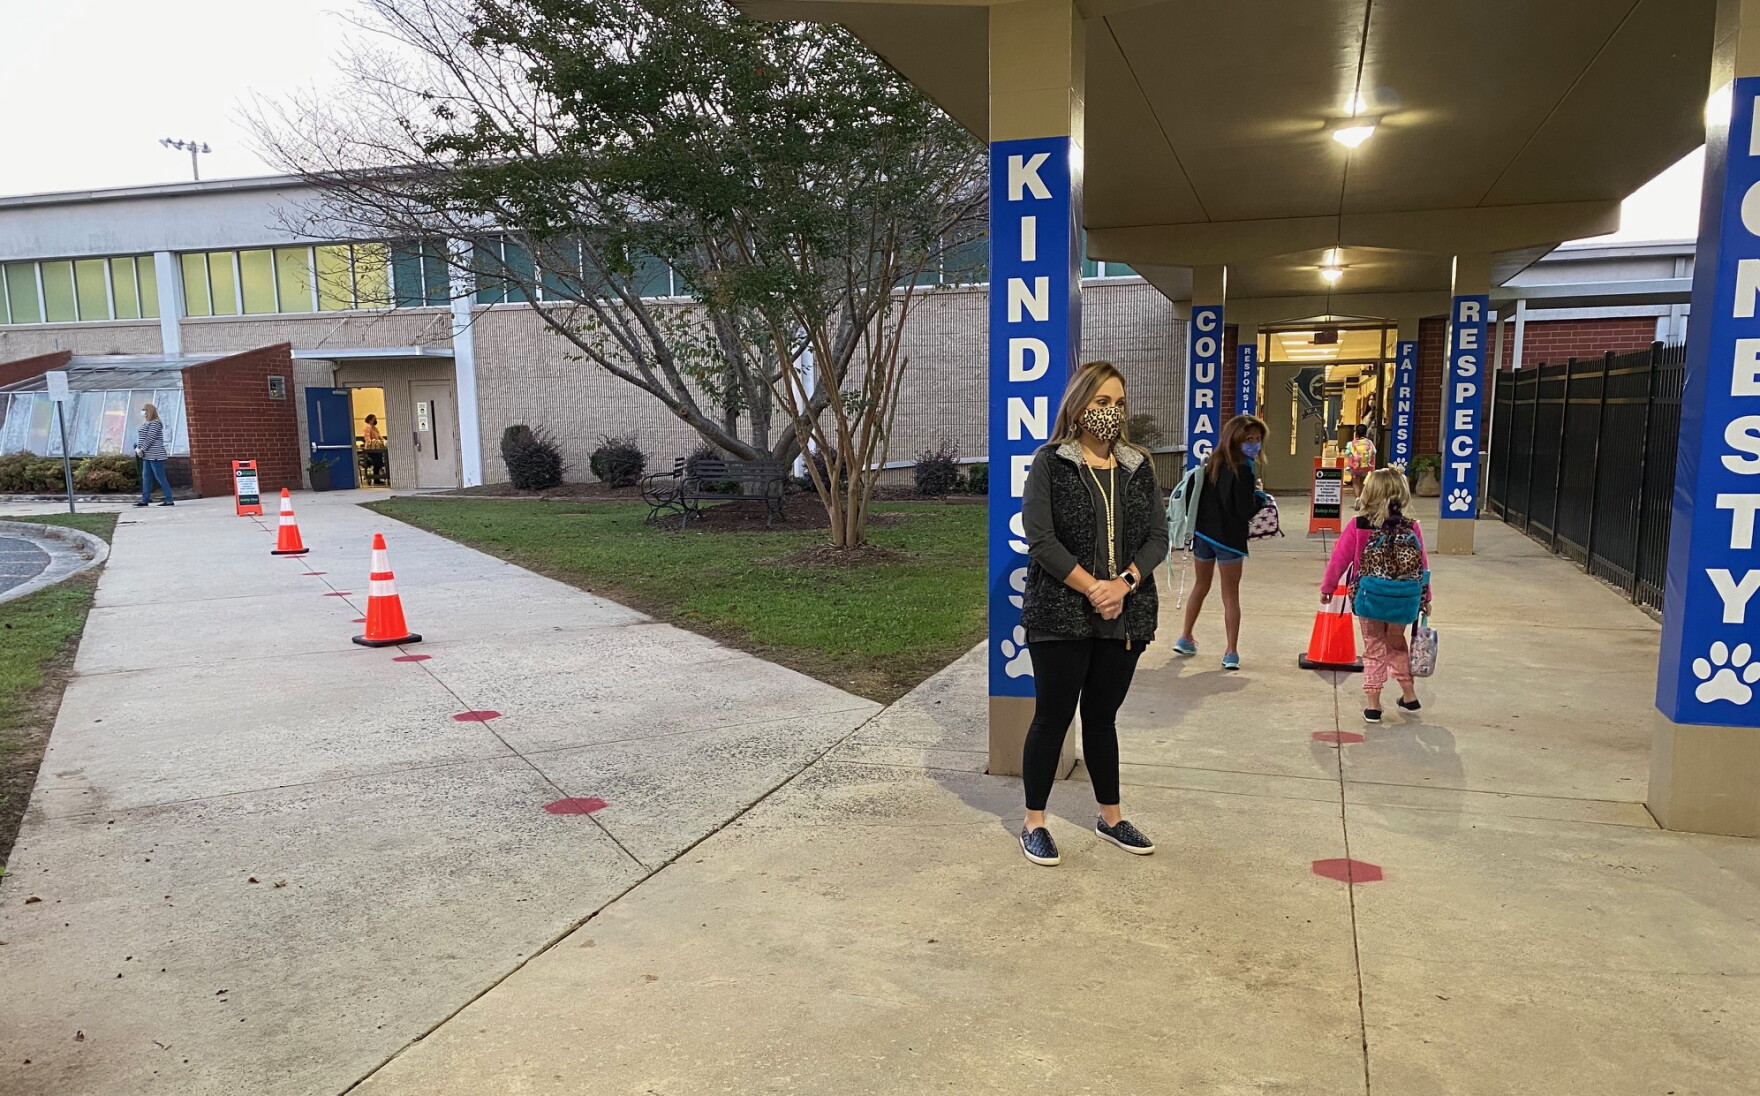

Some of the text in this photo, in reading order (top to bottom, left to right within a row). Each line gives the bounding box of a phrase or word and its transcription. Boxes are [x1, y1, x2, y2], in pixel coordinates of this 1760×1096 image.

[1192, 310, 1217, 468] COURAG
[1396, 344, 1413, 454] FAIRNESS
[1451, 301, 1480, 483] RESPECT
[1705, 95, 1760, 624] ESTY
